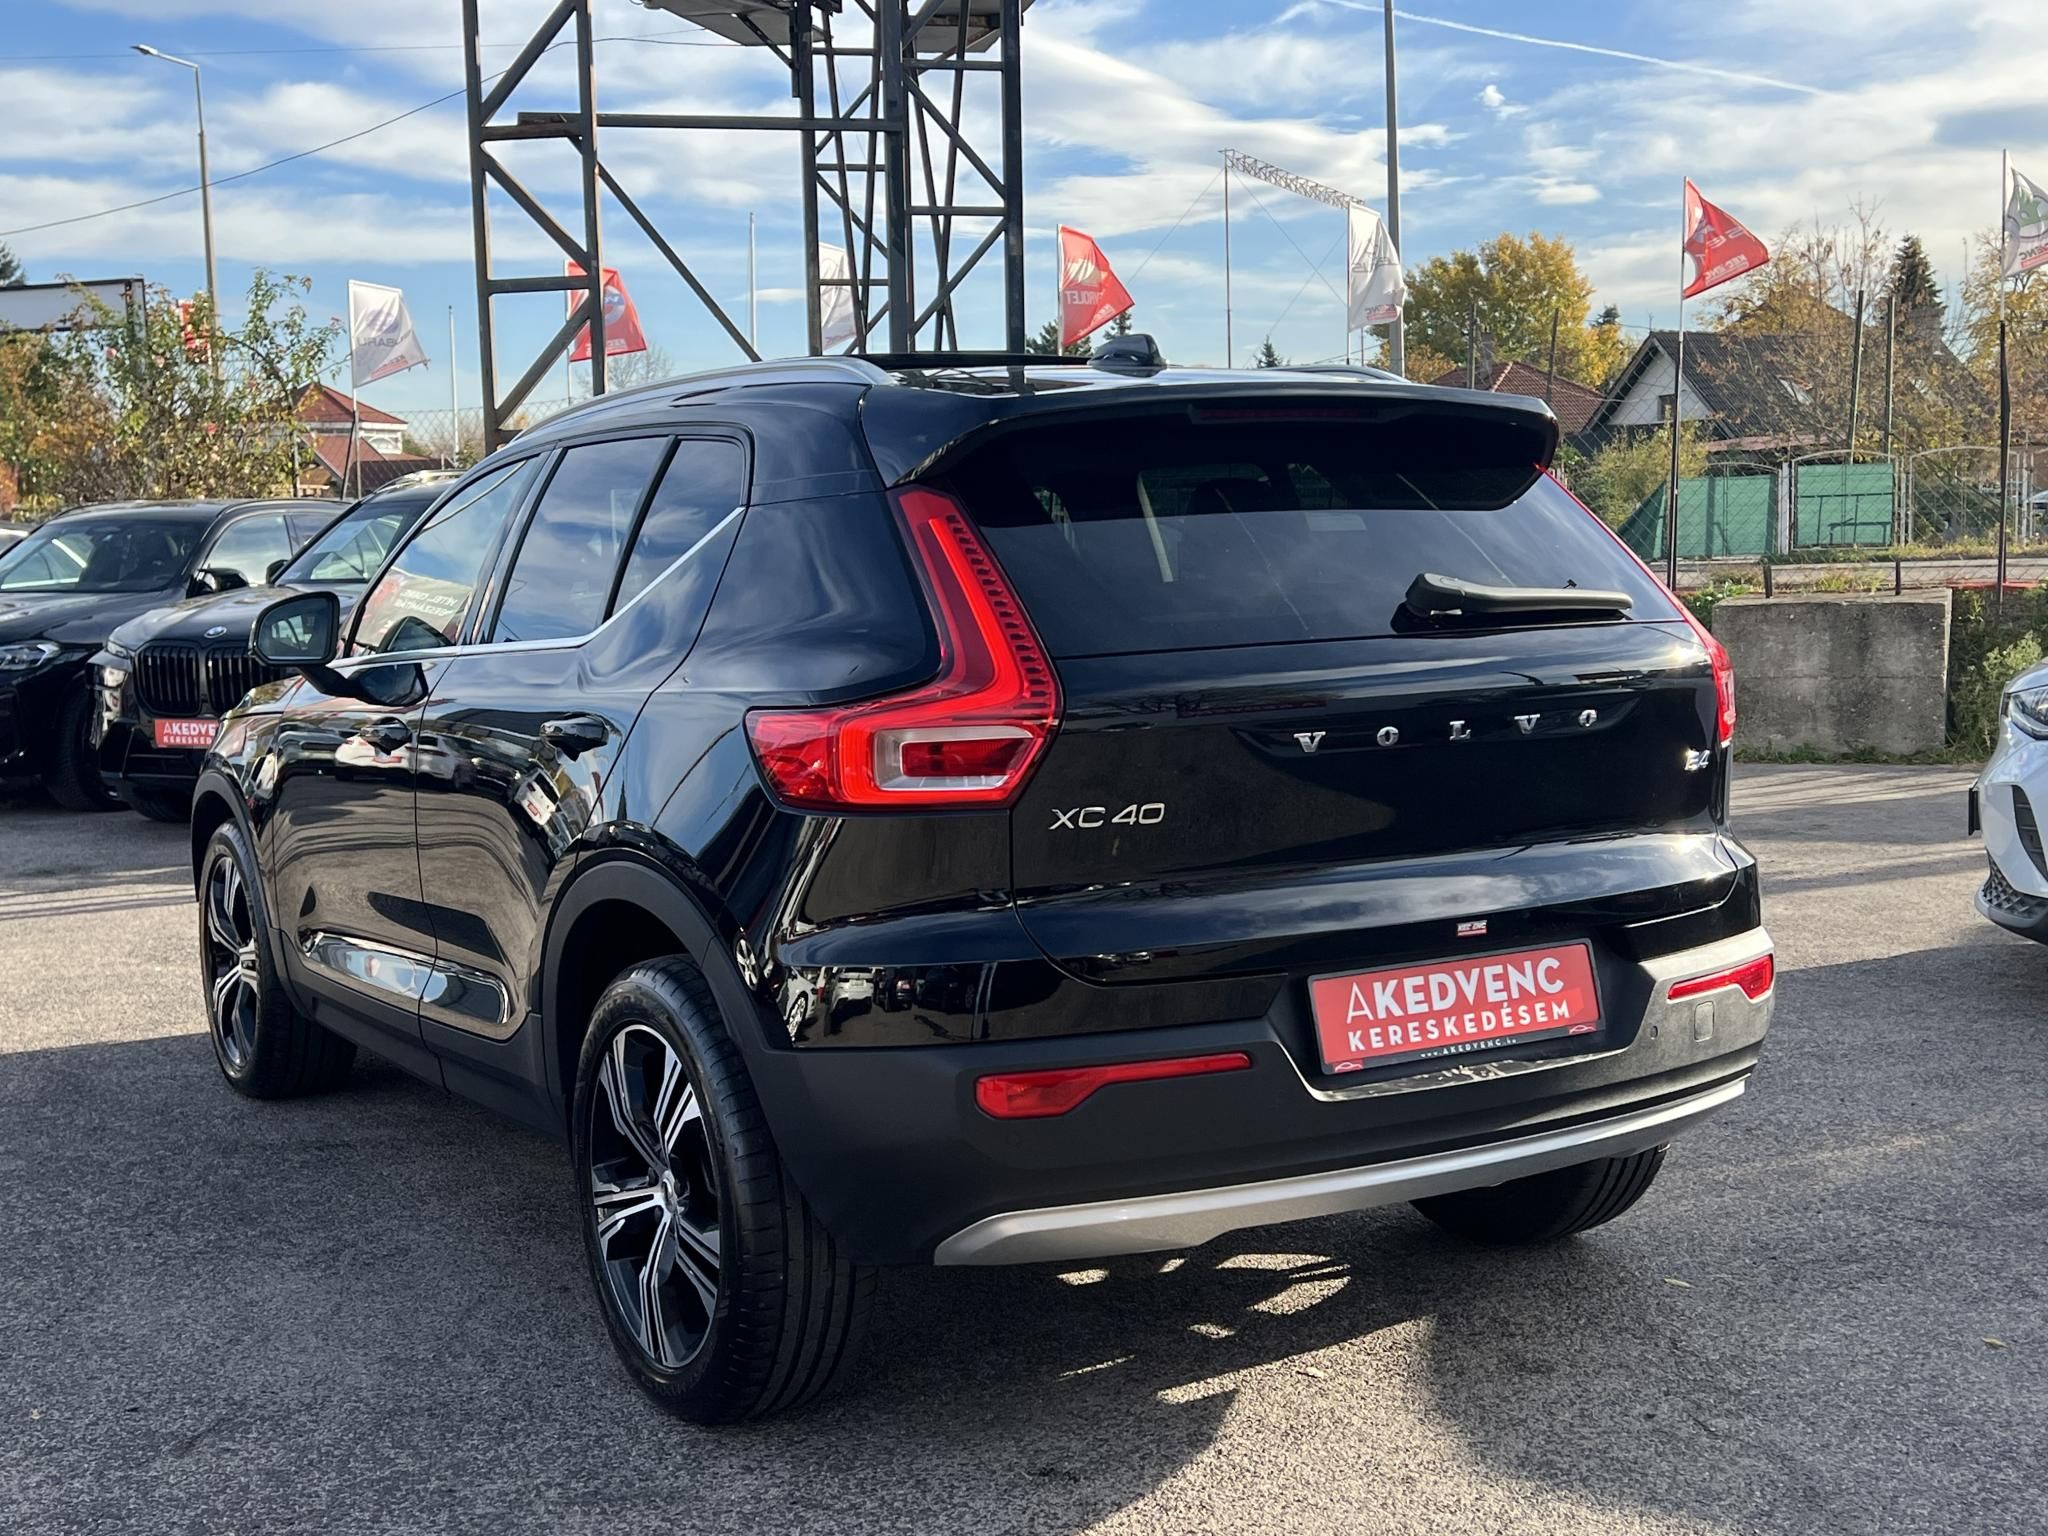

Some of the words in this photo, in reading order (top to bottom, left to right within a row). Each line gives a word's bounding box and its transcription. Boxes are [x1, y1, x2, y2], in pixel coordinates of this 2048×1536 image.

[1293, 709, 1598, 753] VOLVO
[1346, 957, 1565, 1024] AKEDVENC
[1347, 1000, 1570, 1053] KERESKEDÉSEM
